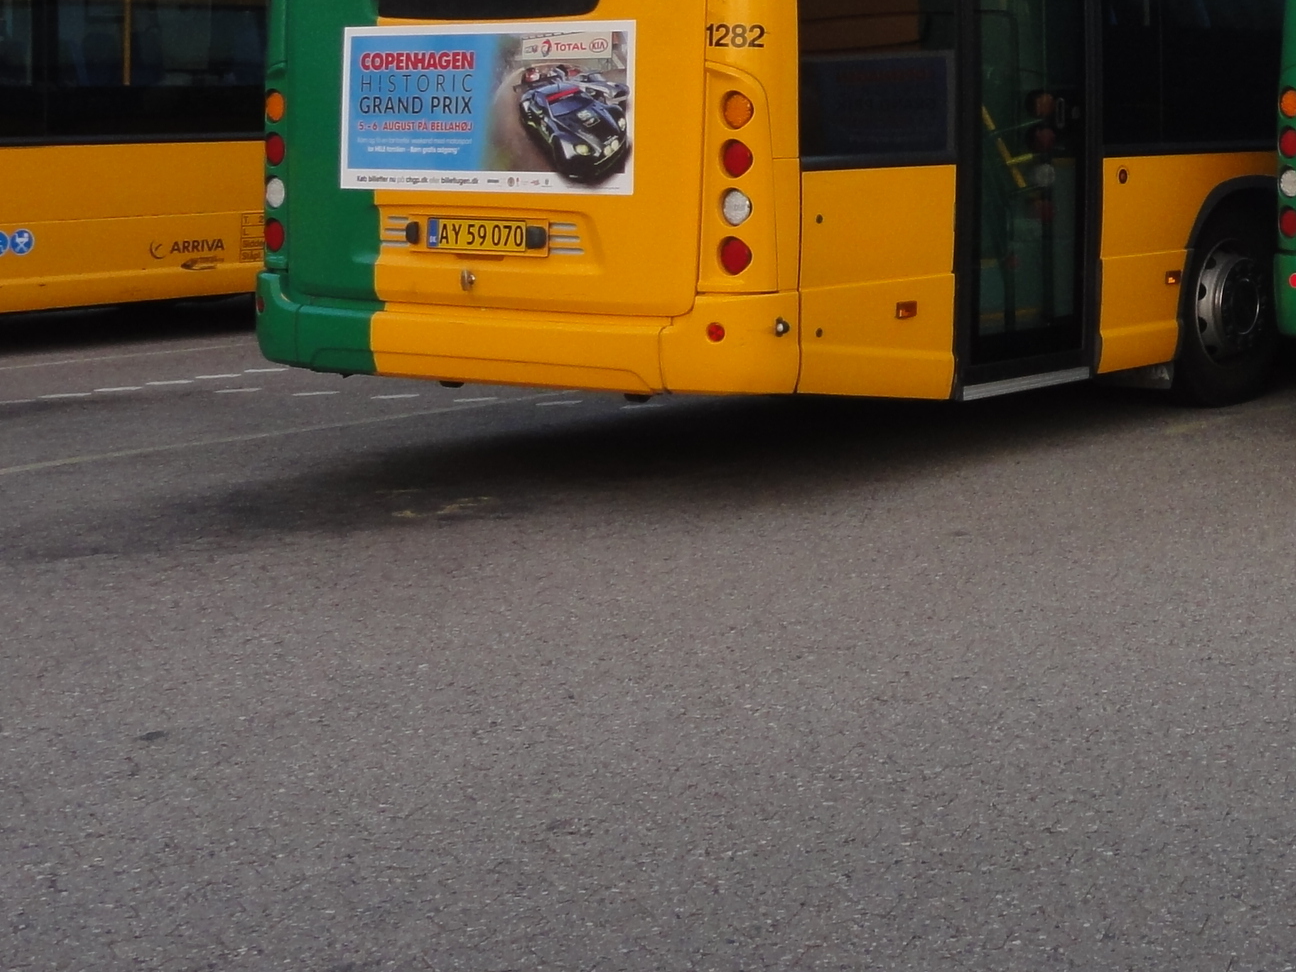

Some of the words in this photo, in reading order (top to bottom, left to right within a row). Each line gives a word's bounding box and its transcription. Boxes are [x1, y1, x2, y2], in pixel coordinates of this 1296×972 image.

[706, 23, 765, 48] 1282
[554, 42, 586, 52] TOTAL
[360, 51, 475, 71] COPENHAGEN
[361, 74, 473, 93] HISTORIC
[360, 96, 423, 114] GRAND
[430, 96, 472, 114] PRIX
[383, 121, 416, 131] AUGUST
[430, 121, 473, 132] BELLAHØJ
[439, 223, 462, 245] AY
[466, 224, 487, 247] 59
[491, 224, 524, 247] 070
[170, 238, 224, 254] ARRIVA
